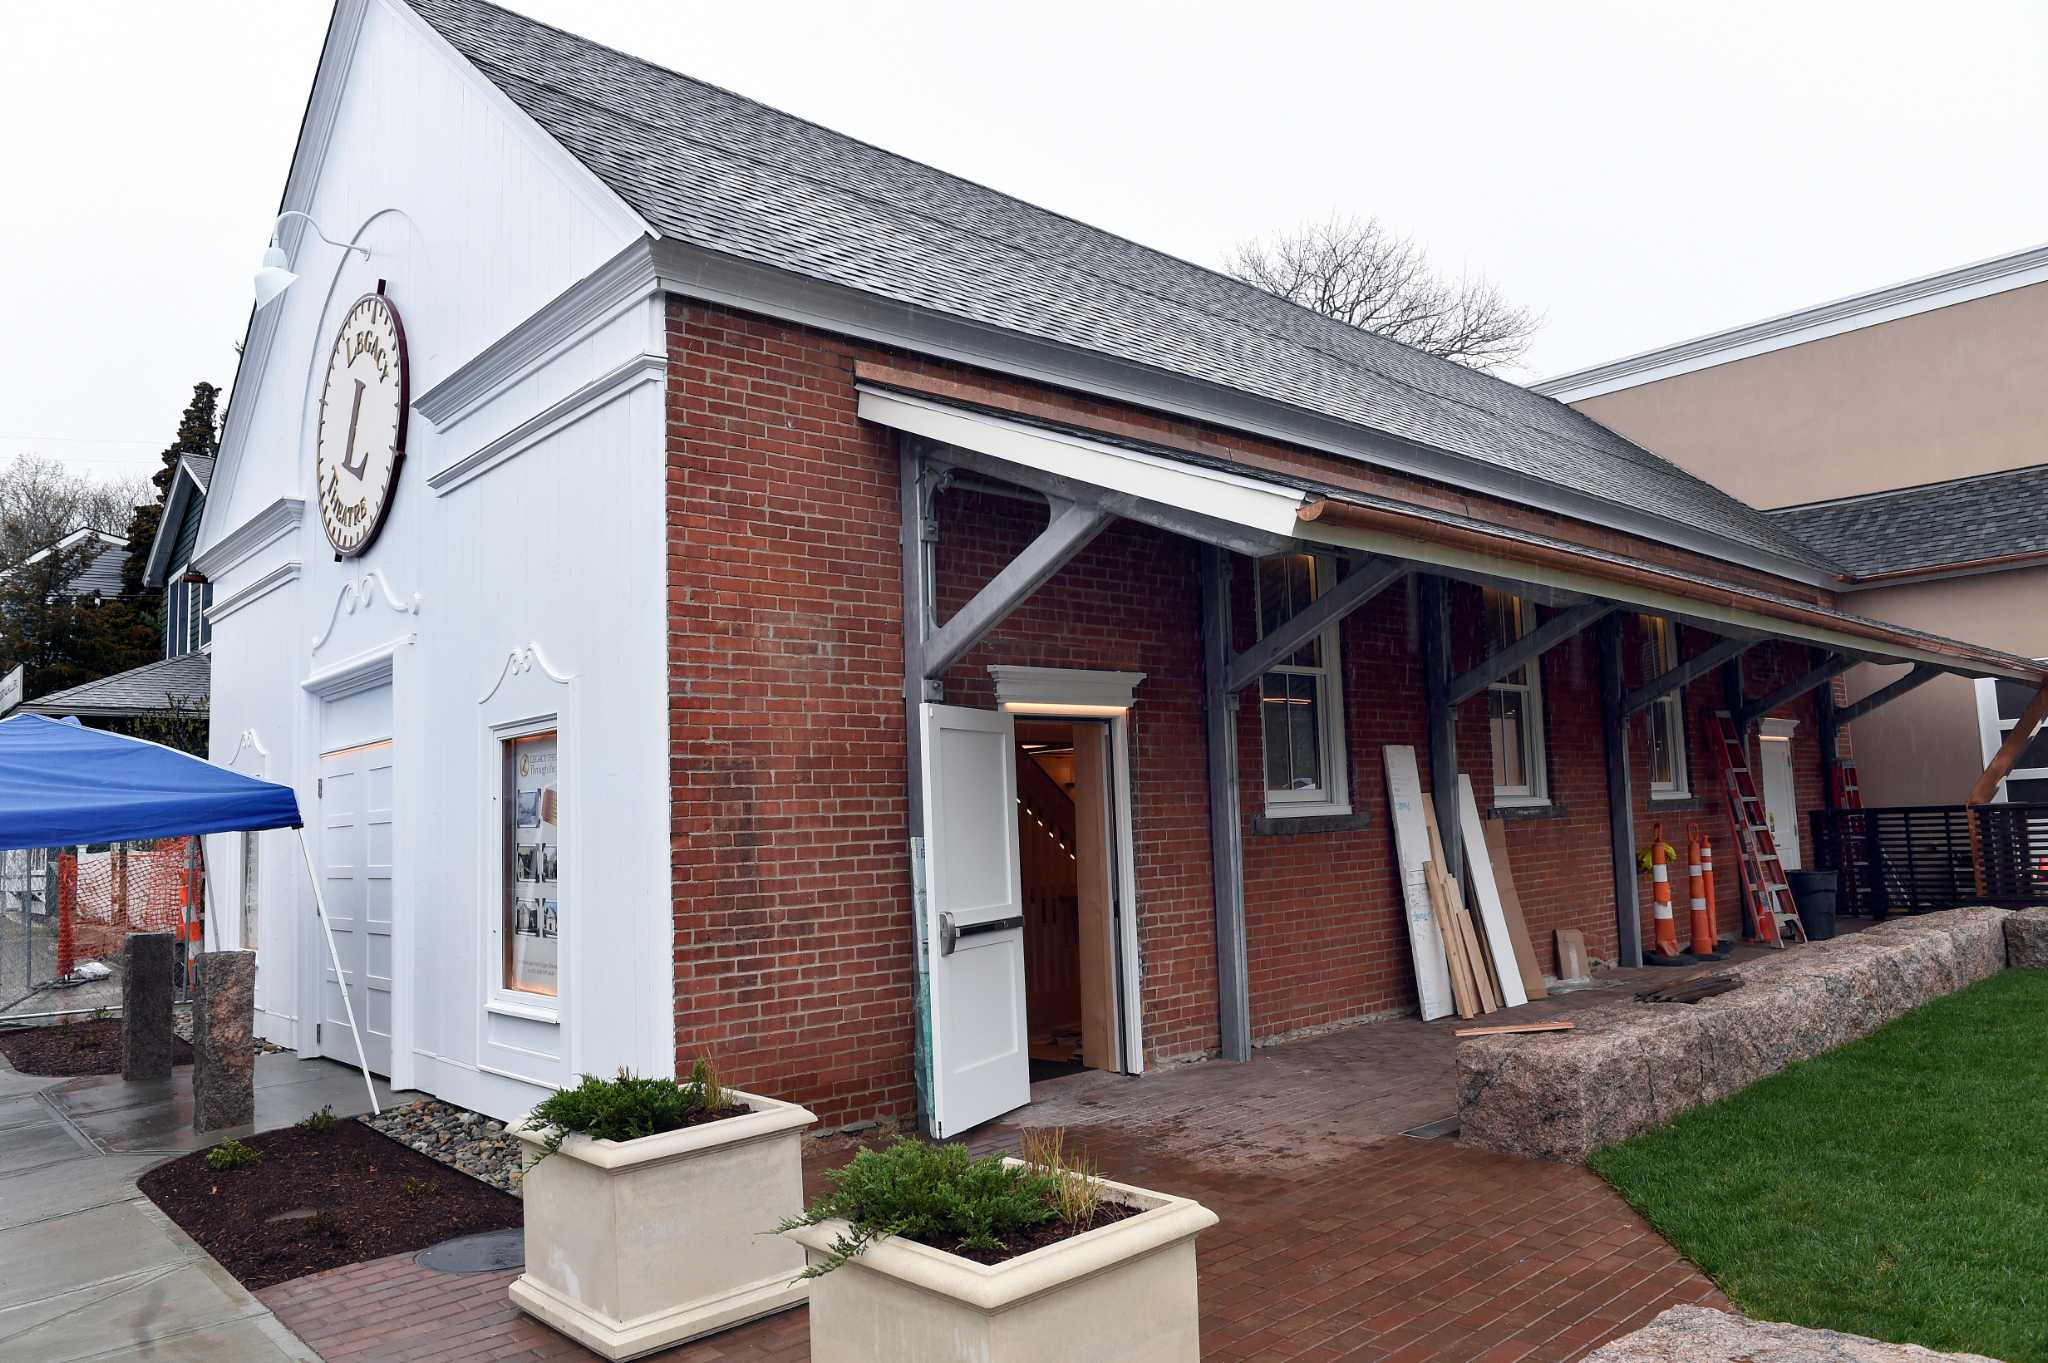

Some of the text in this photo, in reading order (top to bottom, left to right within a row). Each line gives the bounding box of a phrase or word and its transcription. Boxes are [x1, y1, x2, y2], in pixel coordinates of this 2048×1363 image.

[346, 329, 389, 383] LEGACY
[343, 378, 369, 481] L
[327, 464, 368, 527] THEATRE
